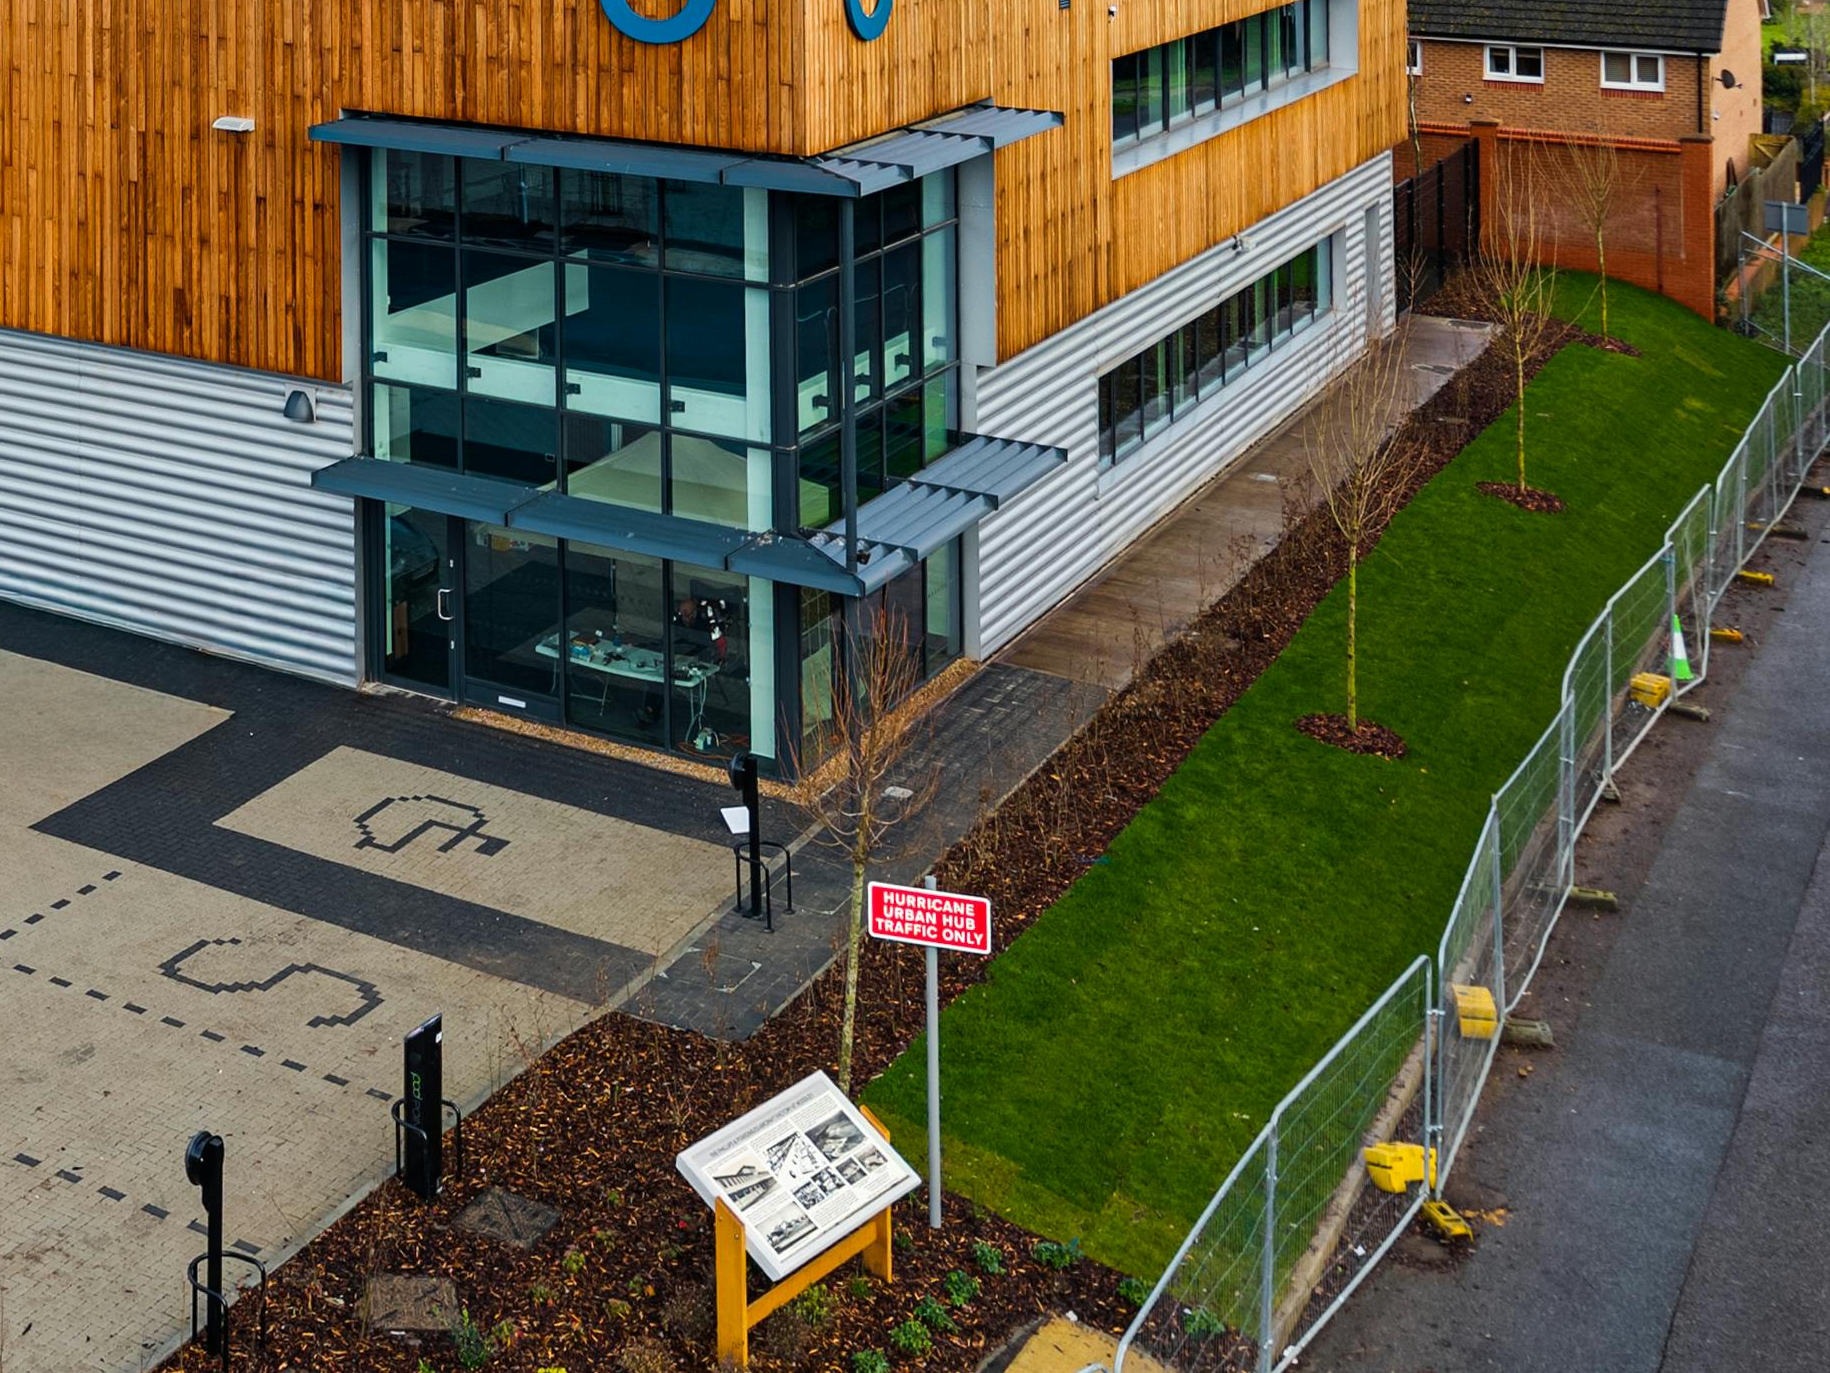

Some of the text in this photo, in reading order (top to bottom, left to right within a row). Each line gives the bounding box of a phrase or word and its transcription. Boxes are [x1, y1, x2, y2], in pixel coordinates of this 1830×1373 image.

[882, 891, 976, 917] HURRICANE
[875, 917, 983, 945] TRAFFIC ONLY
[883, 905, 976, 931] URBAN HUB
